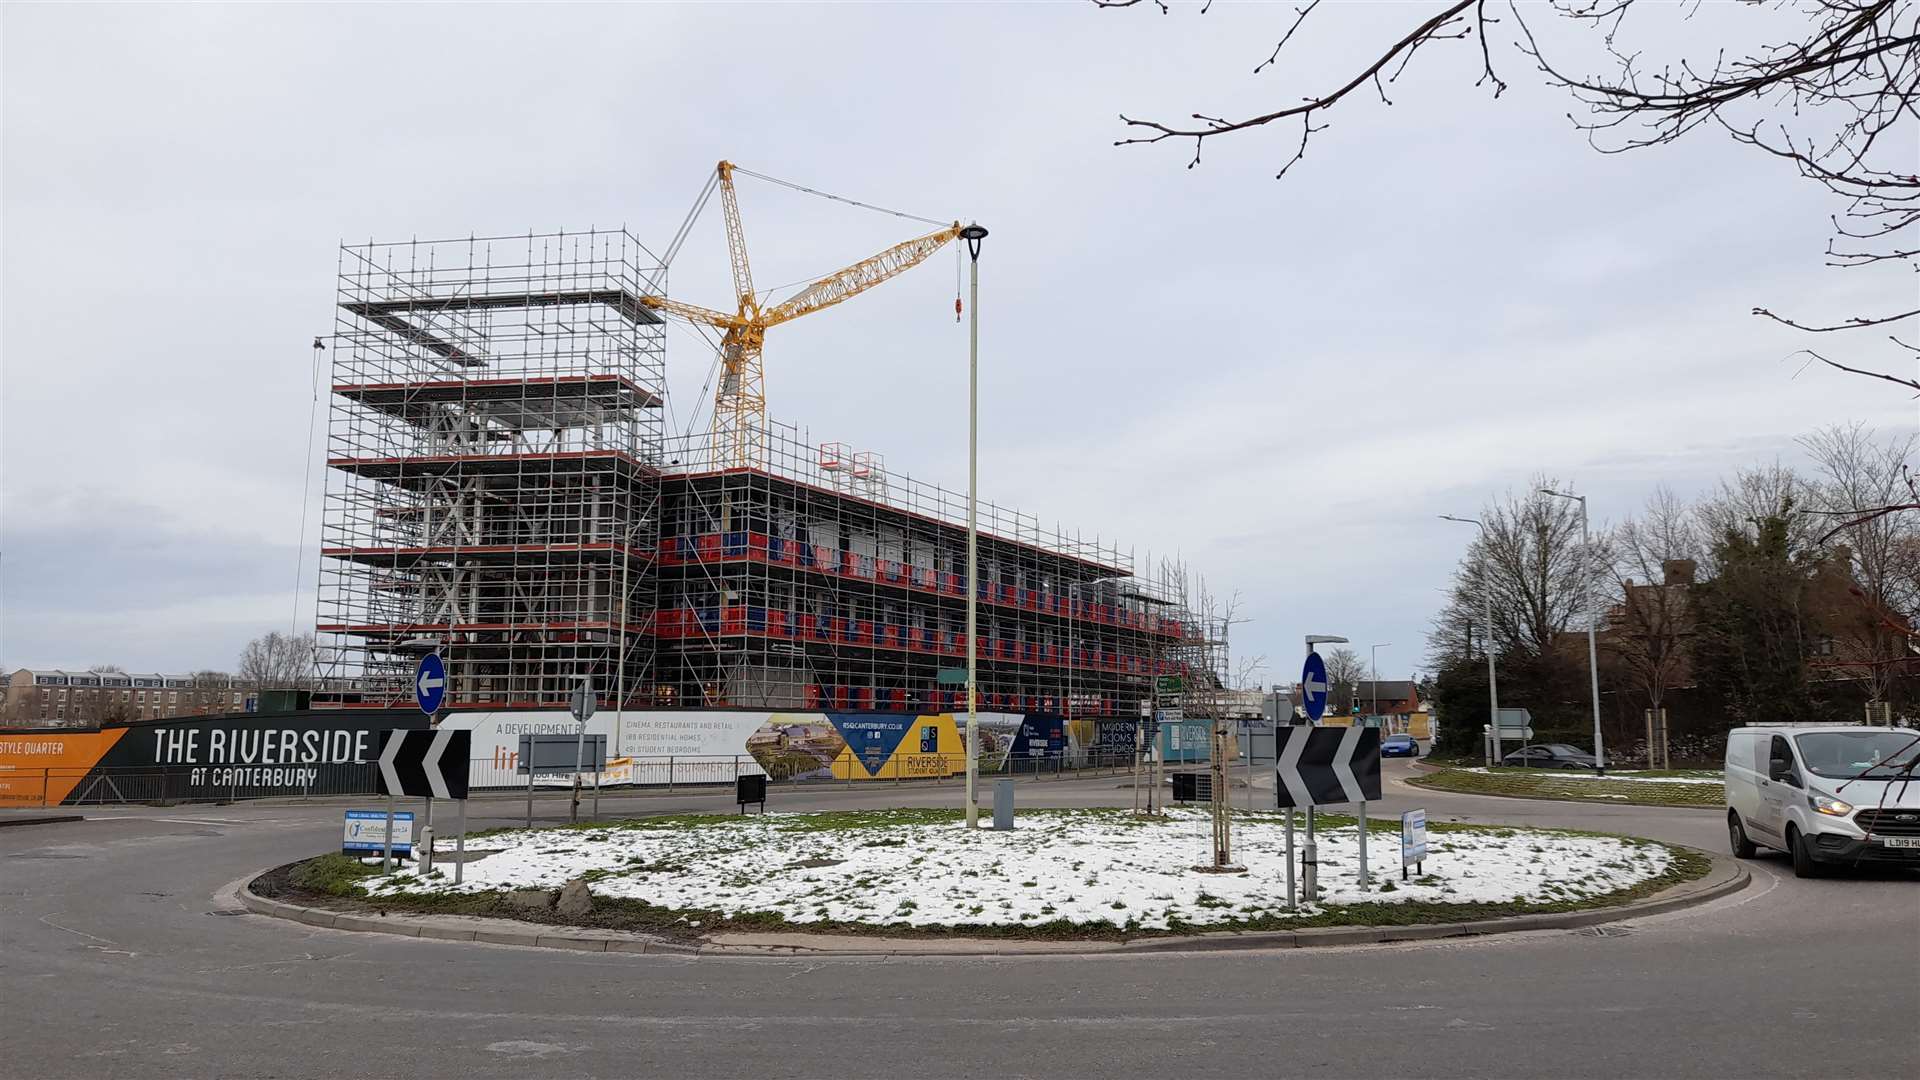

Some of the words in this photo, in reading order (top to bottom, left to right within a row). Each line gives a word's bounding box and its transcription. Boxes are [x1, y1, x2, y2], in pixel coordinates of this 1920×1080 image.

[496, 724, 503, 735] A
[505, 723, 572, 735] DEVELOPMENT
[654, 721, 698, 729] RESTAURANTS
[713, 722, 733, 730] RETAIL
[1102, 722, 1135, 731] MODERN
[679, 734, 702, 742] HOMES
[1102, 733, 1132, 743] ROOMS
[24, 742, 64, 755] QUARTER
[154, 728, 200, 763] THE
[209, 728, 369, 764] RIVERSIDE
[667, 746, 701, 754] BEDROOMS
[677, 760, 723, 773] SUMMER
[727, 760, 750, 773] 221
[907, 756, 949, 768] RIVERSIDE
[190, 767, 207, 786] AT
[212, 767, 318, 787] CANTERBURY
